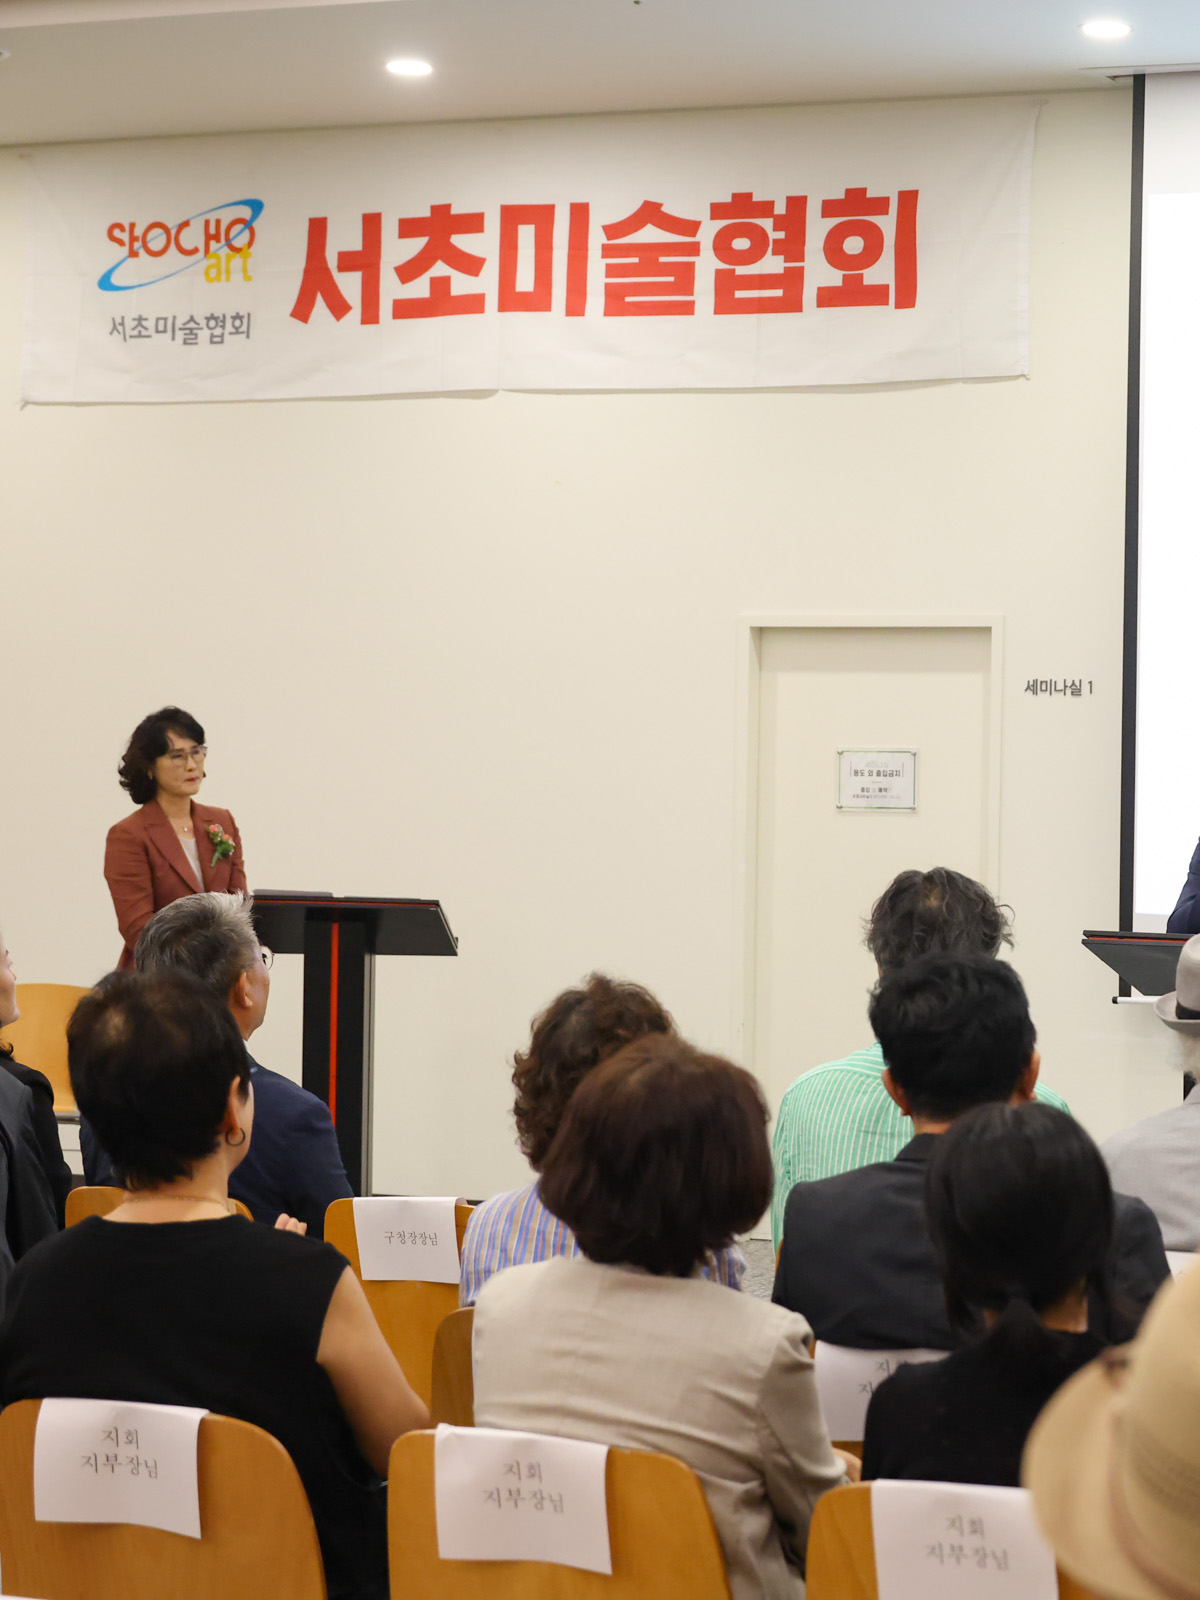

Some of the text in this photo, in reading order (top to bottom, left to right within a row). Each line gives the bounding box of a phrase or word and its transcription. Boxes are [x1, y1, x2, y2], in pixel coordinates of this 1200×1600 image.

[107, 217, 256, 258] SEOCHO
[204, 243, 253, 283] art
[289, 187, 919, 325] 서초미술협회
[109, 312, 252, 346] 서초미술협회
[1024, 678, 1093, 697] 세미나실 1
[384, 1230, 438, 1246] 구청장장님
[101, 1426, 139, 1450] 지회
[80, 1452, 159, 1479] 지부장님
[503, 1460, 543, 1485] 지회
[482, 1486, 564, 1515] 지부장님
[925, 1541, 1009, 1572] 지부장님
